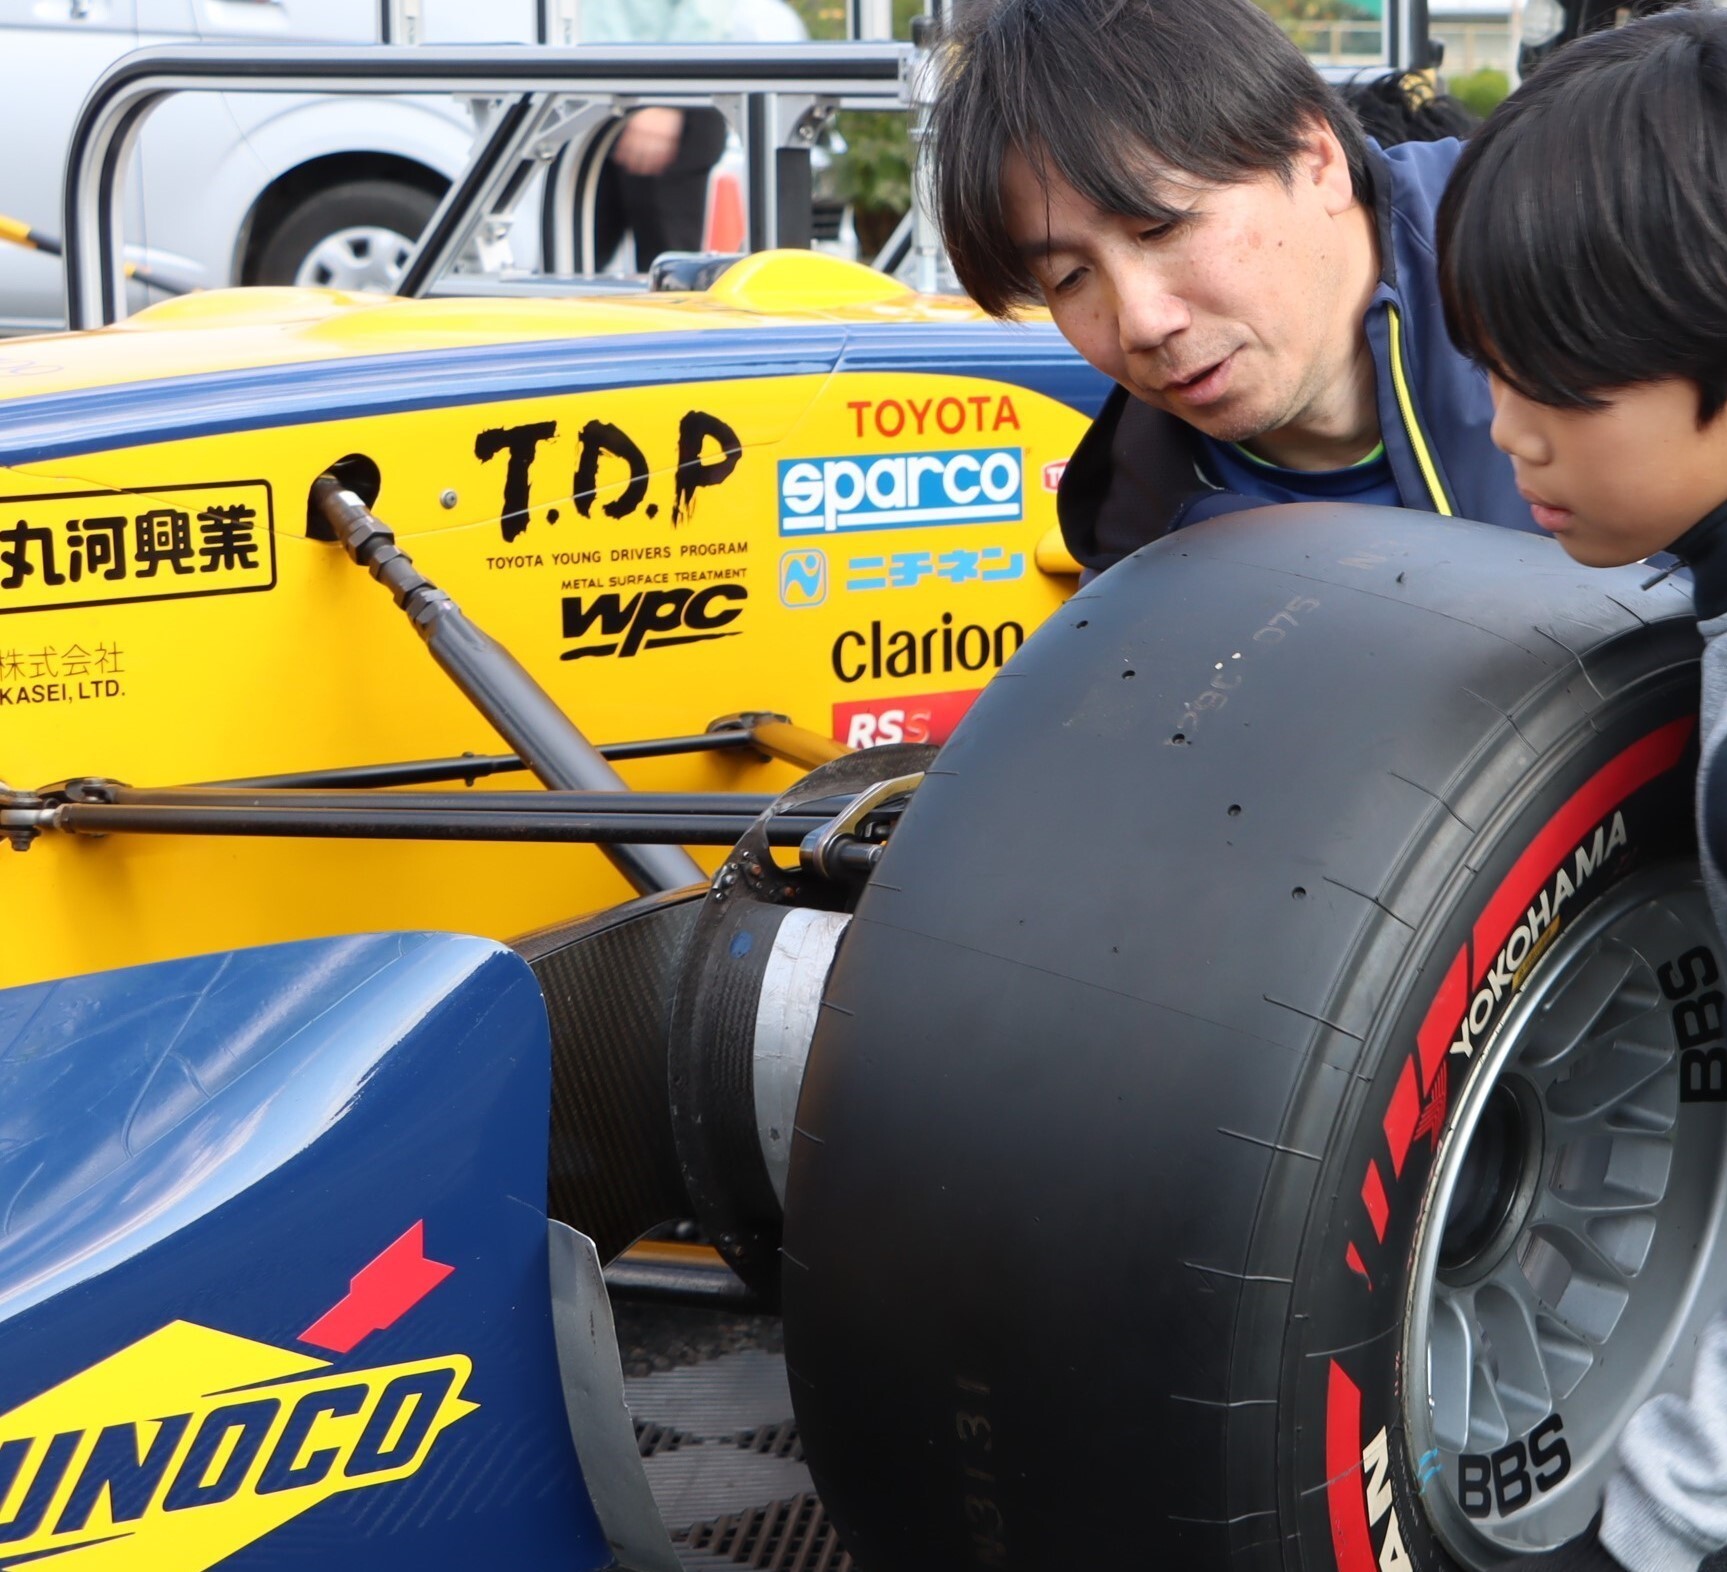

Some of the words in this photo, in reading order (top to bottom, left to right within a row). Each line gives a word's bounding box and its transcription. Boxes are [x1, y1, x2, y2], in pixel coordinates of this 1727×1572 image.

[847, 396, 1021, 438] TOYOTA
[783, 452, 1020, 531] sparco
[0, 504, 259, 589] 丸河興業
[486, 555, 544, 570] TOYOTA
[552, 551, 601, 565] YOUNG
[610, 546, 671, 562] DRIVERS
[680, 541, 748, 557] PROGRAM
[561, 577, 604, 590] METAL
[609, 573, 668, 588] SURFACE
[674, 568, 748, 583] TREATMENT
[846, 547, 1024, 590] ニチネン
[79, 679, 125, 700] LTD.
[1449, 810, 1628, 1059] YOKOHAMA
[1458, 1413, 1571, 1518] BBS
